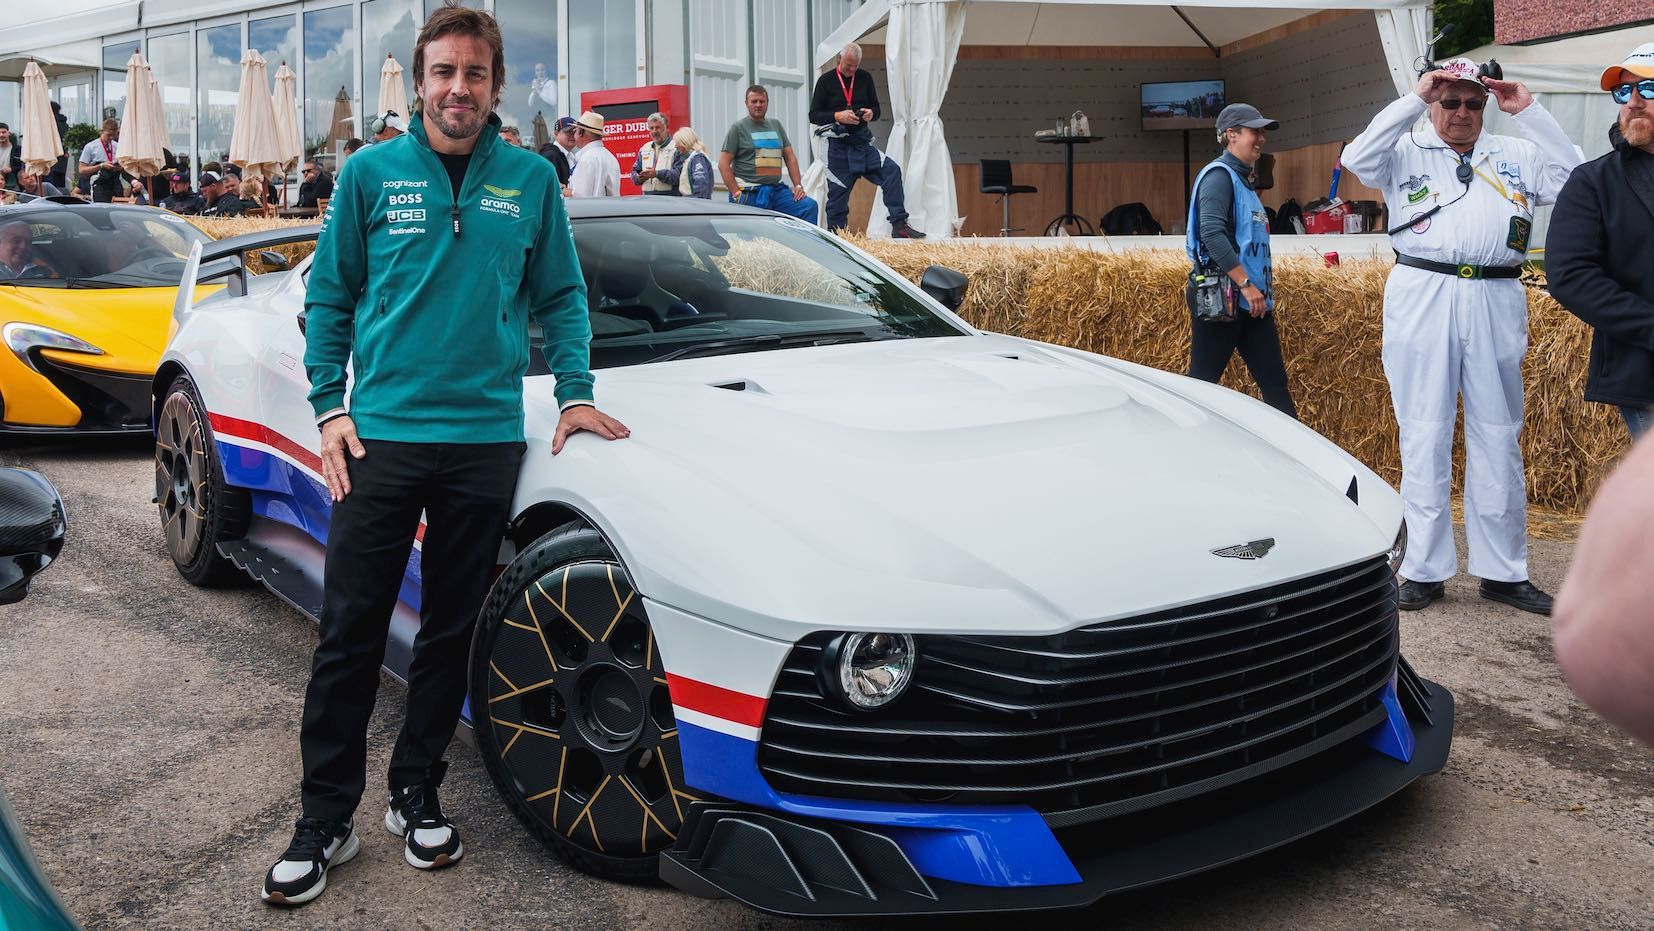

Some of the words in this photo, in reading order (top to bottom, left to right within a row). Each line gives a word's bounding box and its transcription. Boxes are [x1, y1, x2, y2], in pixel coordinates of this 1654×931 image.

[603, 124, 624, 134] GER
[383, 180, 428, 189] cognizant
[389, 193, 422, 205] BOSS
[481, 199, 520, 213] aramco
[388, 210, 425, 222] JCB
[389, 227, 426, 235] SentinelOne
